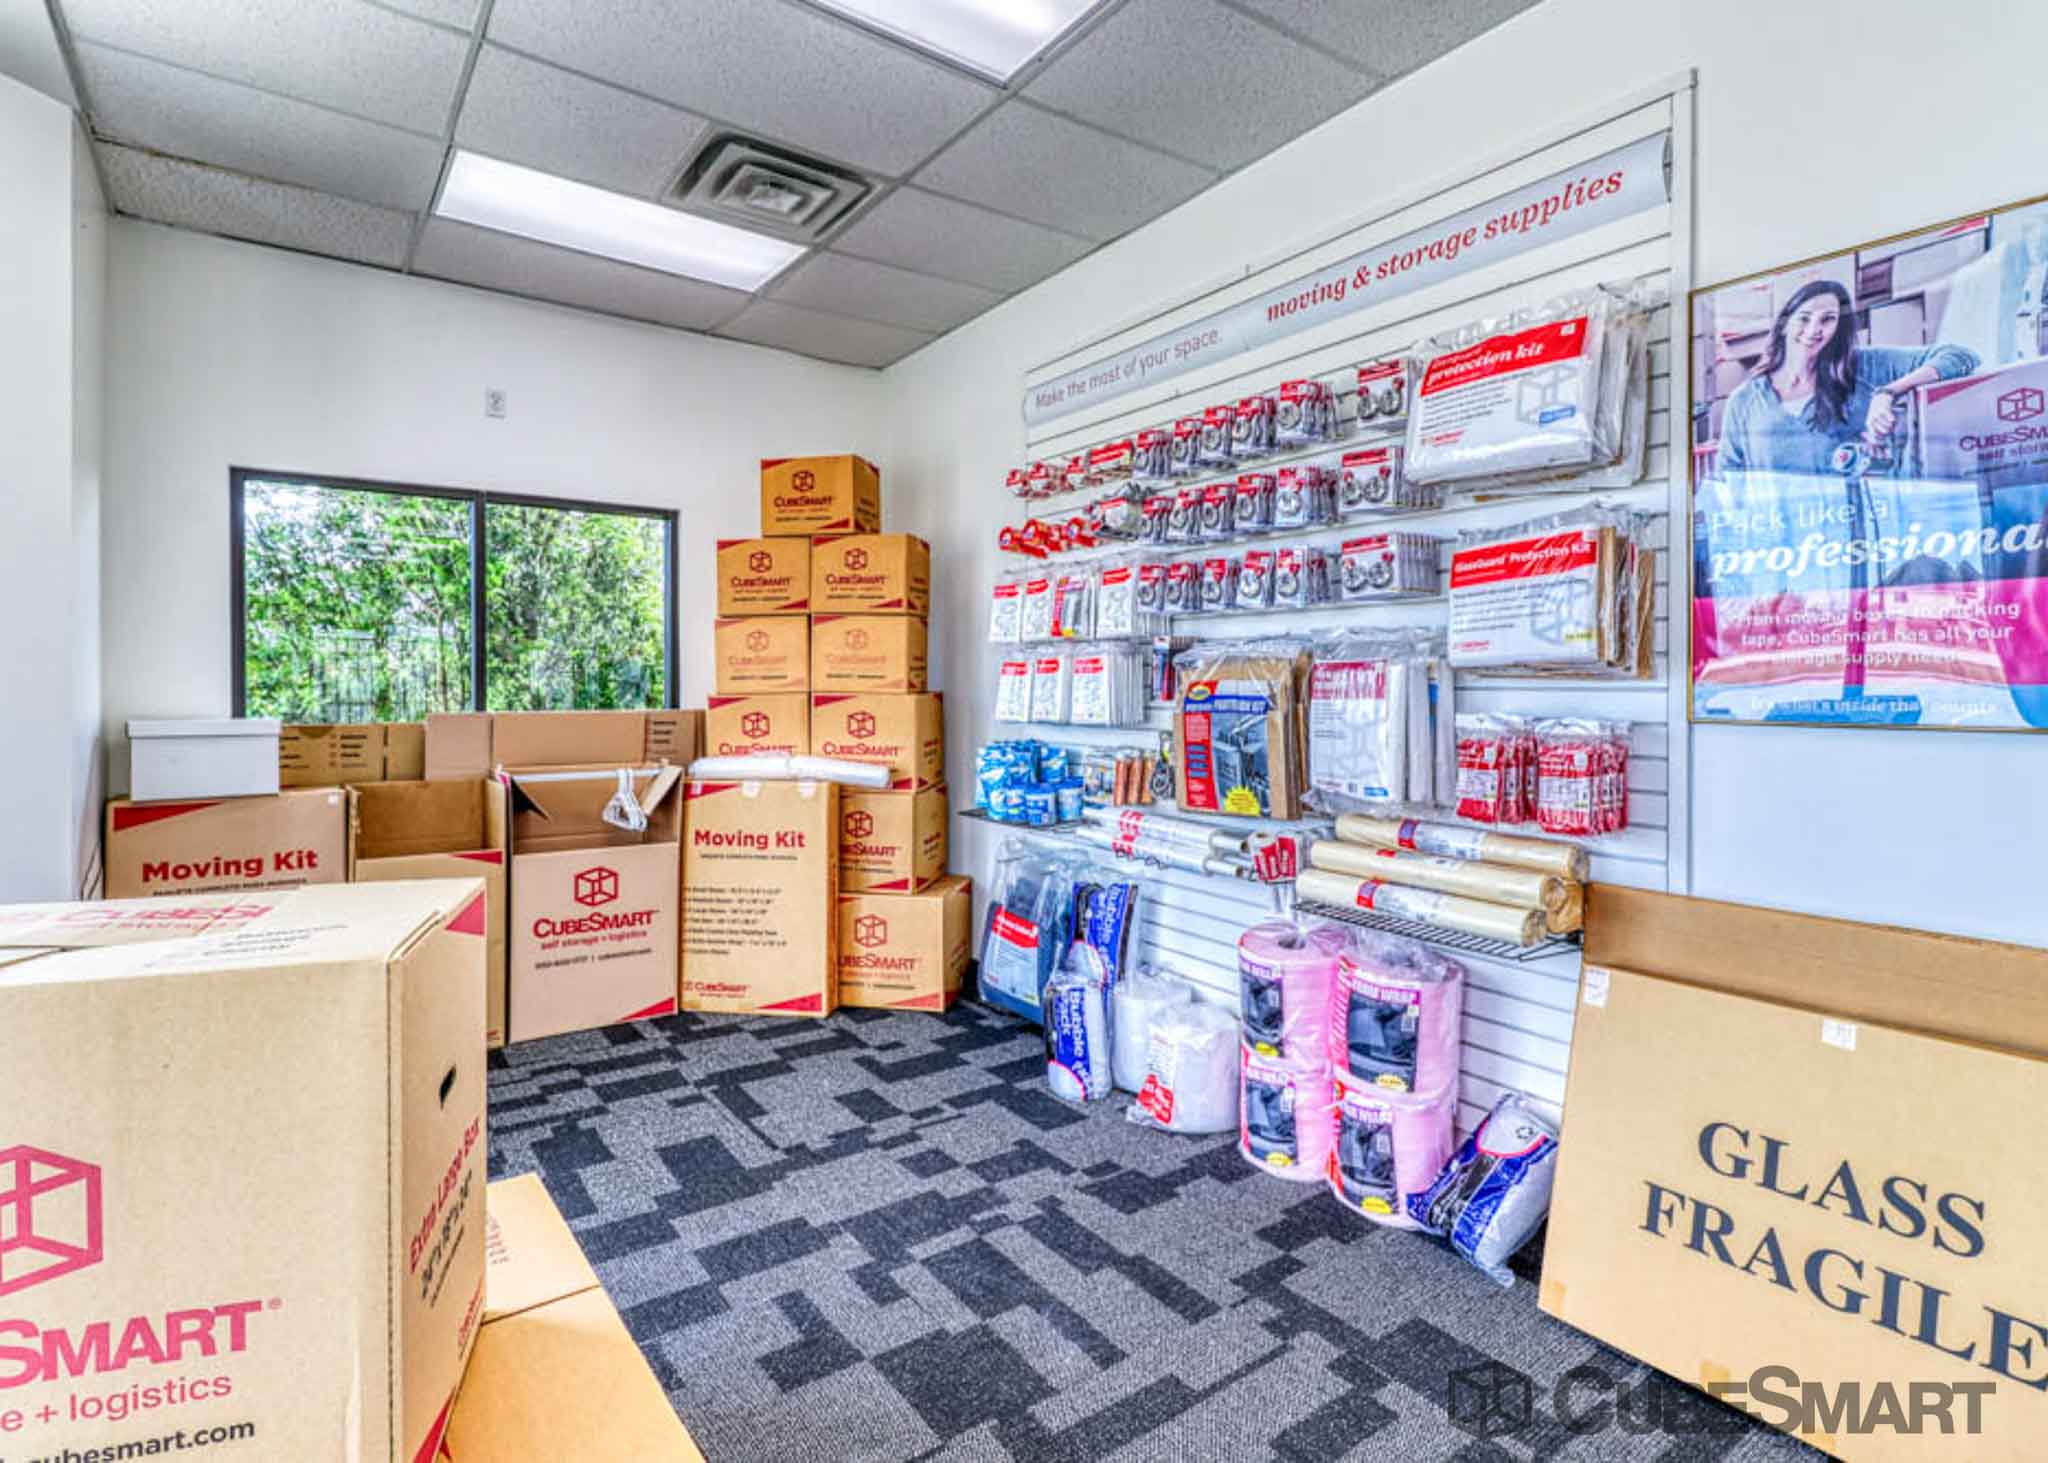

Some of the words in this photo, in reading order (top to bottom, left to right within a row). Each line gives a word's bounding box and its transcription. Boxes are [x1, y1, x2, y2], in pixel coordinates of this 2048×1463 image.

[1067, 379, 1087, 396] the
[1089, 366, 1120, 390] most
[1123, 357, 1137, 379] of
[1138, 348, 1171, 377] your
[1174, 328, 1223, 361] space.
[1265, 274, 1347, 322] moving
[1351, 265, 1372, 291] &
[1376, 226, 1478, 282] storage
[1483, 169, 1625, 241] supplies
[1515, 342, 1547, 360] kit
[1711, 509, 1786, 537] Pack
[1798, 501, 1858, 528] like
[1710, 522, 2048, 580] professiona
[1935, 625, 1961, 642] all
[1965, 625, 2015, 644] your
[693, 829, 770, 851] Moving
[775, 831, 806, 849] Kit
[142, 856, 264, 884] Moving
[274, 849, 319, 872] Kit
[533, 910, 655, 939] CUBESMART
[1698, 1121, 1987, 1260] GLASS
[1638, 1179, 2048, 1394] FRAGILE
[69, 1375, 234, 1422] logistics
[28, 1420, 256, 1463] besmart.com
